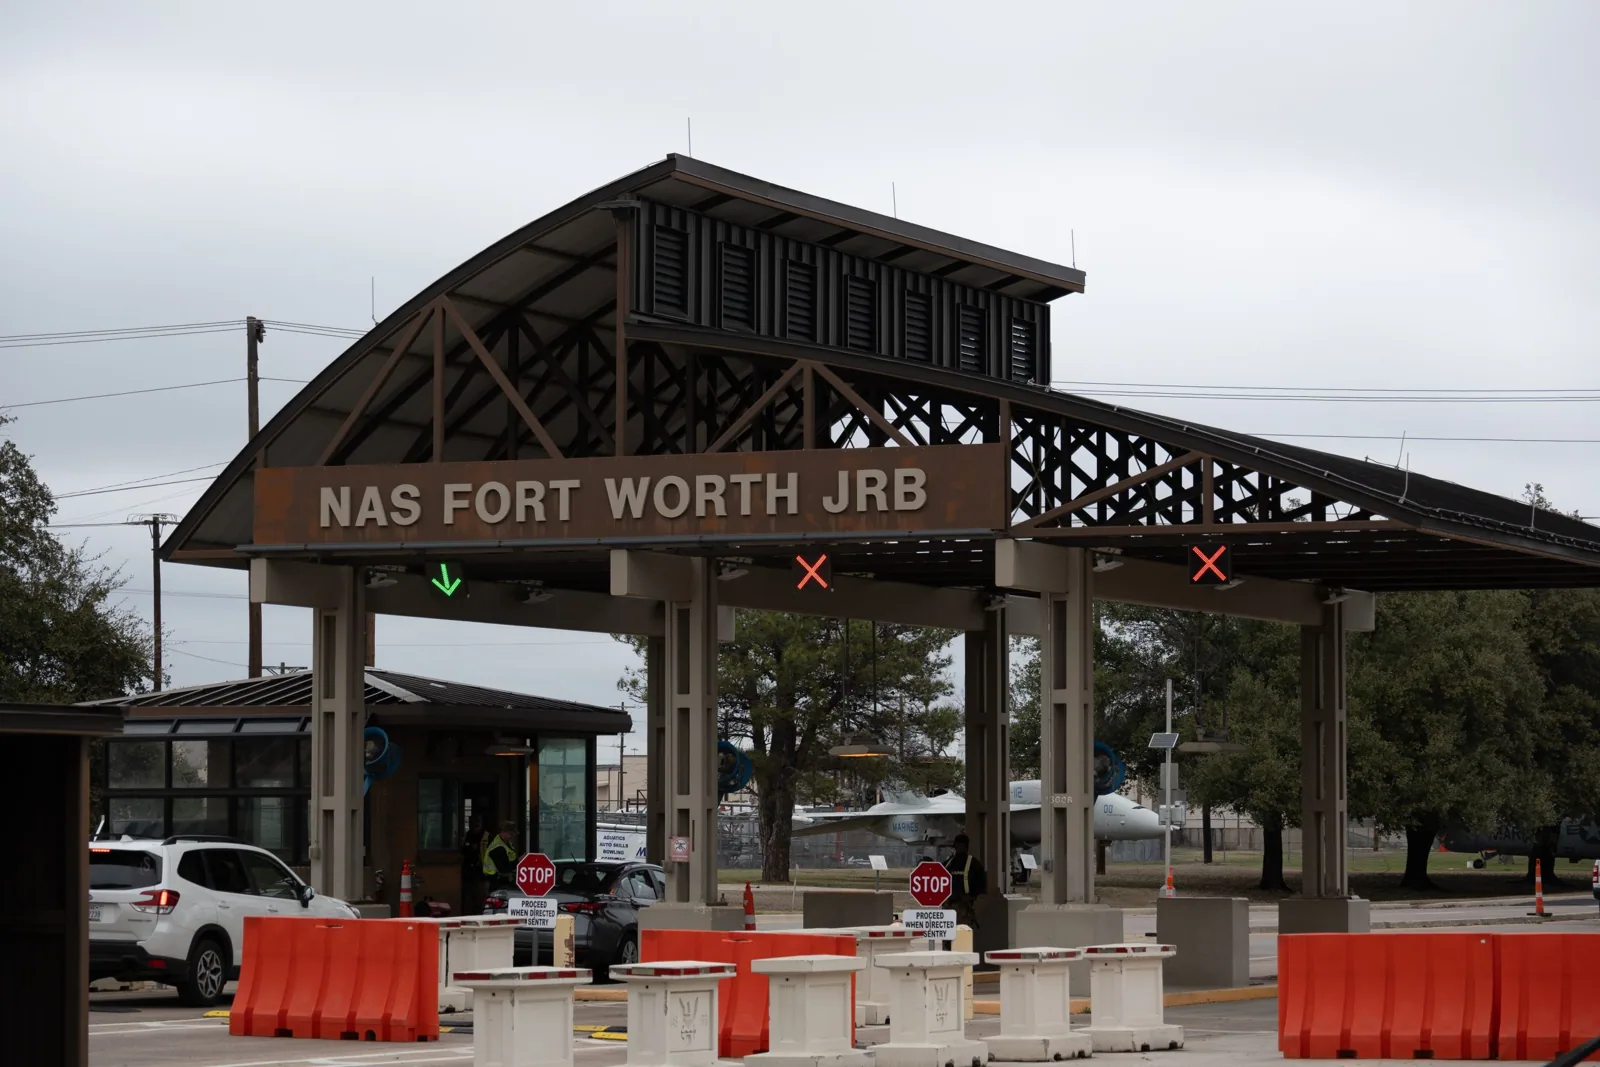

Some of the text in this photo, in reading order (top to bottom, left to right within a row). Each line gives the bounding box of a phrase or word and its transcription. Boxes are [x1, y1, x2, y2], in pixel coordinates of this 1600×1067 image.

[320, 468, 928, 528] NAS FORT WORTH JRB
[892, 822, 919, 833] MARINES
[519, 866, 553, 884] STOP
[912, 875, 950, 893] STOP
[521, 900, 548, 909] PROCEED
[510, 908, 556, 918] WHEN DIRECTED
[916, 911, 945, 920] PROCEED
[527, 918, 549, 926] SENTRY
[905, 920, 955, 929] WHEN DIRECTED
[923, 930, 947, 938] SENTRY
